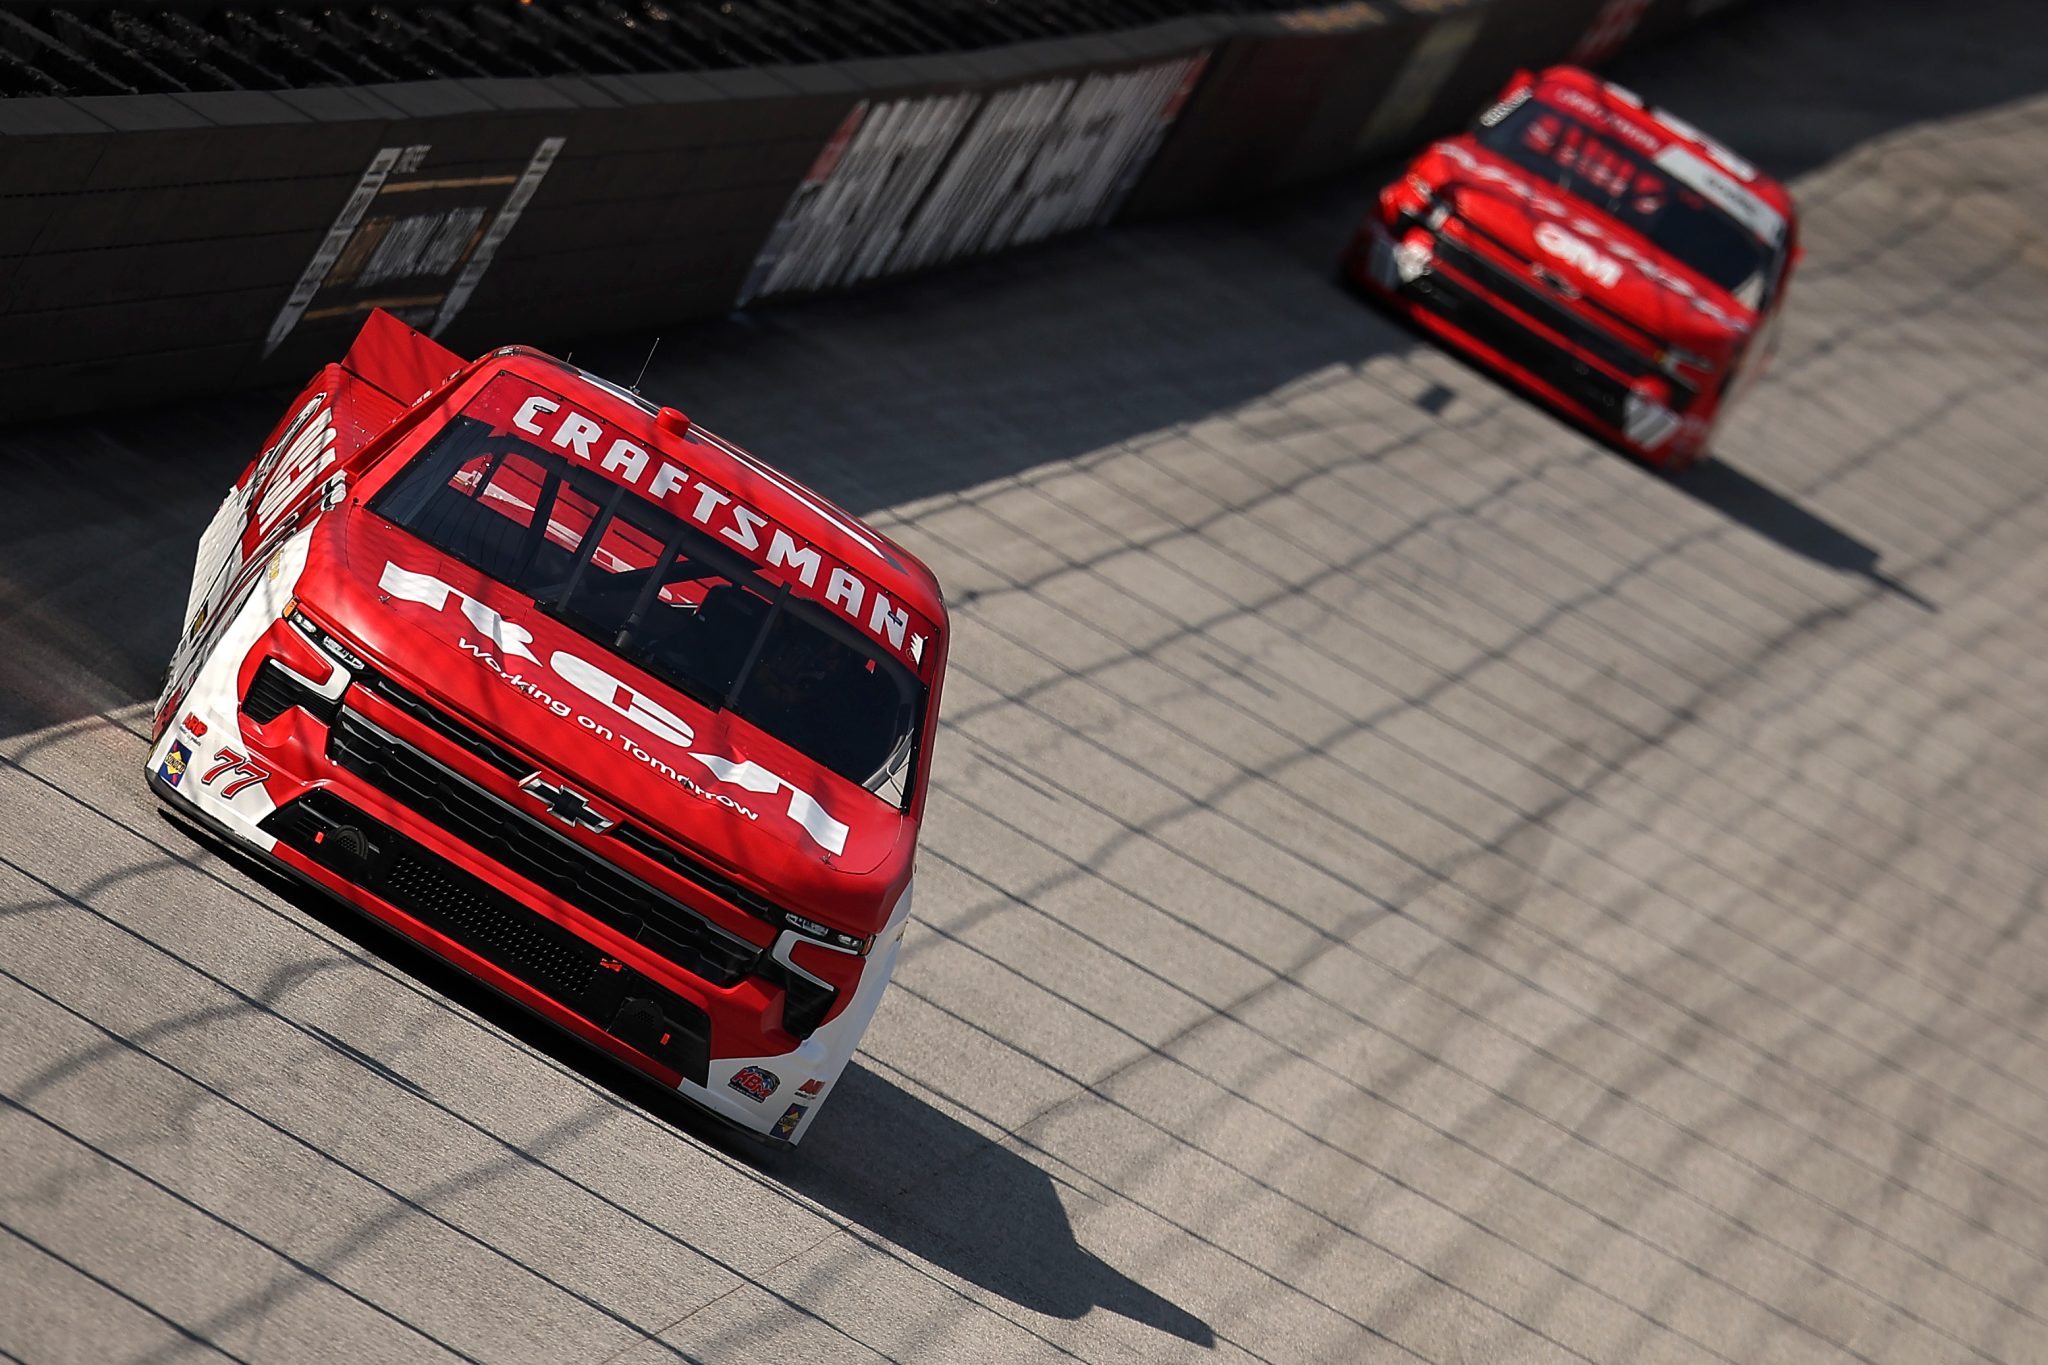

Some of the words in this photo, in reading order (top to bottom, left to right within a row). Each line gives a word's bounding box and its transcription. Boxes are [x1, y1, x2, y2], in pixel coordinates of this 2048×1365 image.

[512, 395, 909, 651] CRAFTSMAN
[201, 745, 272, 800] 77
[458, 637, 572, 717] Working
[577, 714, 614, 741] on
[619, 734, 759, 820] Tomorrow
